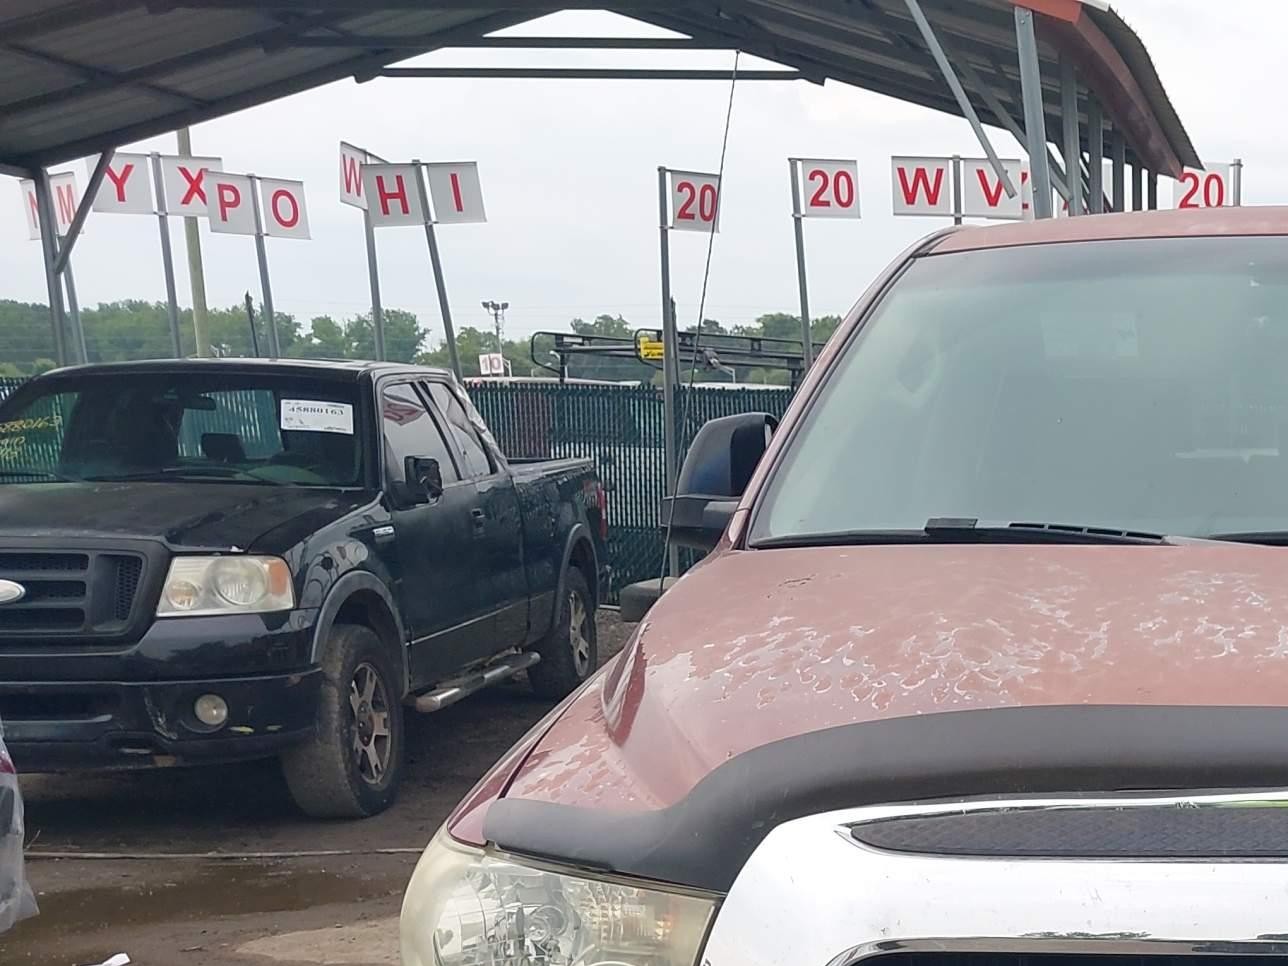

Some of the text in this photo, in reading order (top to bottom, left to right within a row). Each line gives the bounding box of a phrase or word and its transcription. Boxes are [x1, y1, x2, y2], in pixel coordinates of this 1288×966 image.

[106, 164, 134, 202] Y
[177, 166, 208, 206] X
[217, 183, 242, 222] P
[376, 175, 410, 215] H
[450, 173, 463, 212] I
[677, 181, 718, 222] 20
[808, 169, 855, 209] 20
[897, 167, 944, 206] W
[1179, 172, 1224, 209] 20
[272, 189, 299, 228] O
